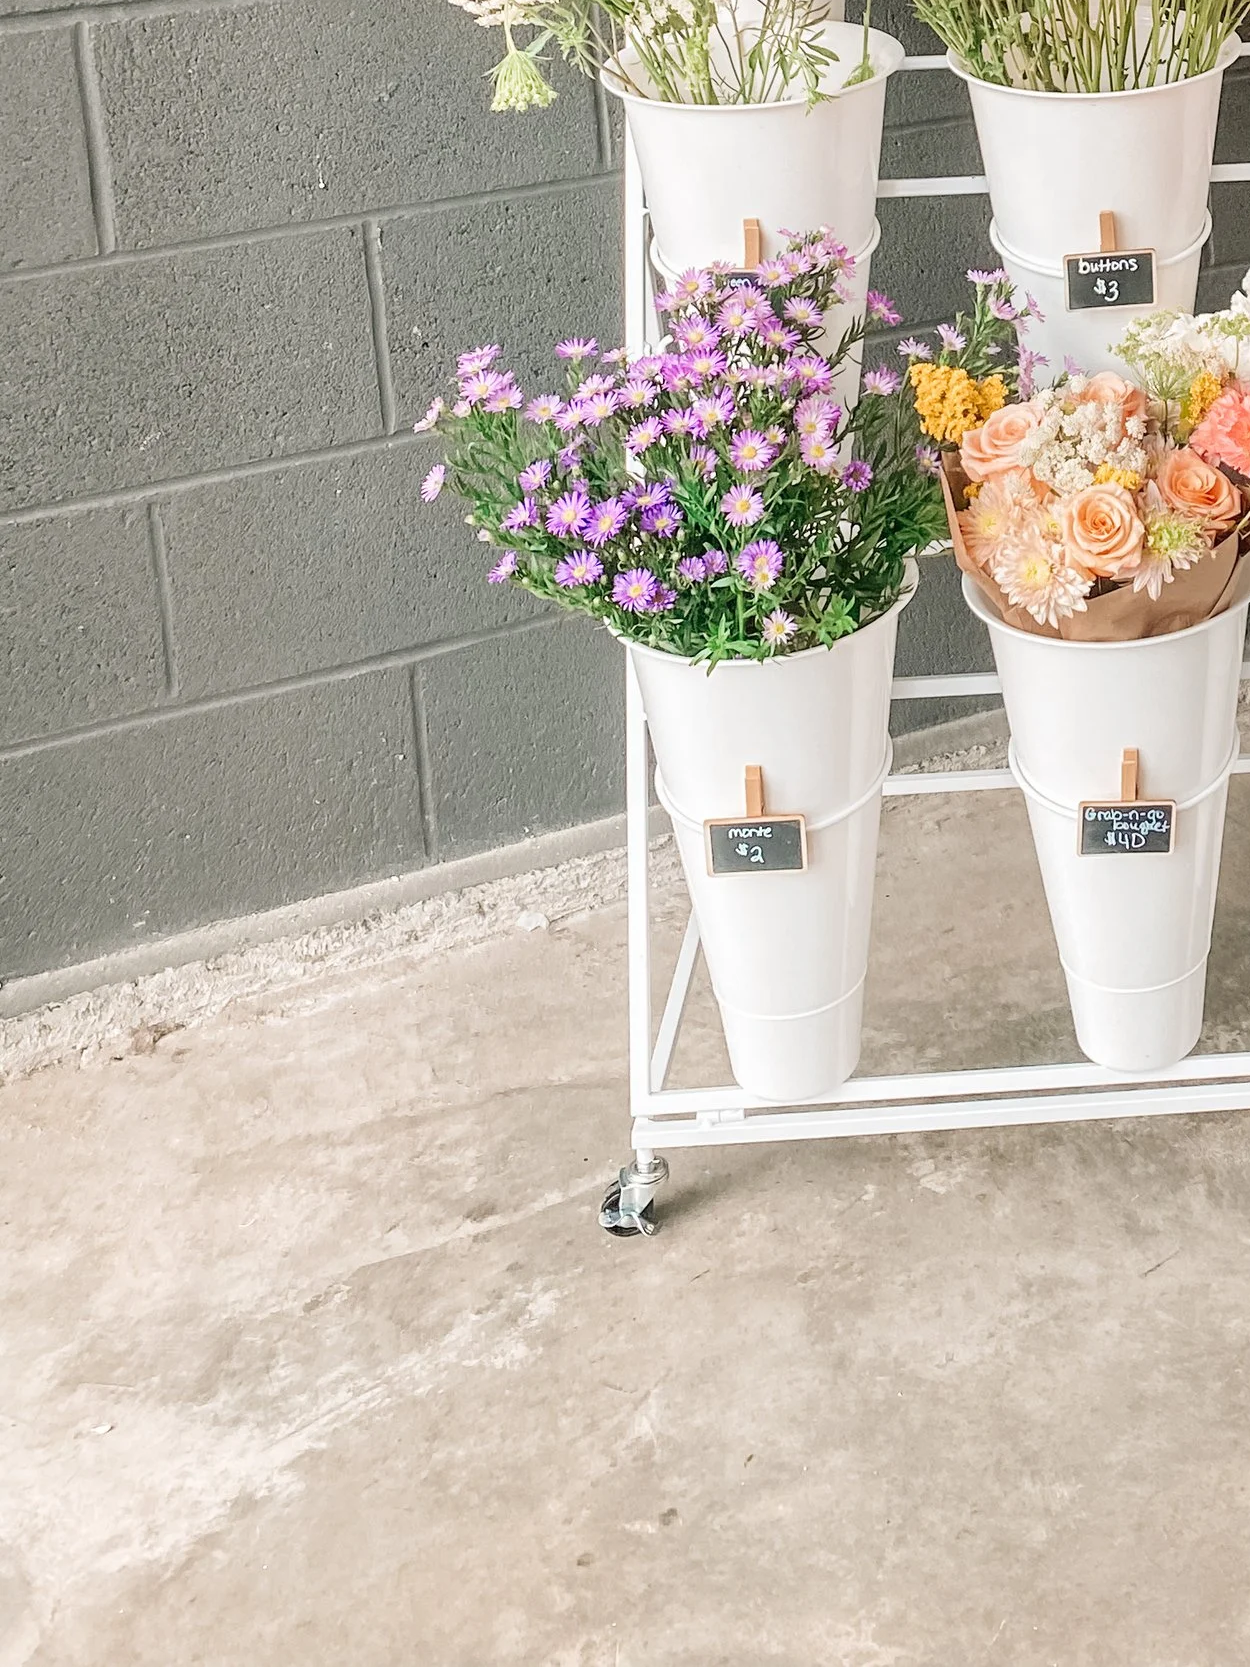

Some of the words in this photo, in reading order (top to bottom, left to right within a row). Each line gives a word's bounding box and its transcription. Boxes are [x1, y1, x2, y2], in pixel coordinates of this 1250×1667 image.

[1078, 257, 1139, 275] buttons
[1093, 277, 1120, 302] $3
[1104, 832, 1146, 849] $40
[735, 843, 765, 864] $2
